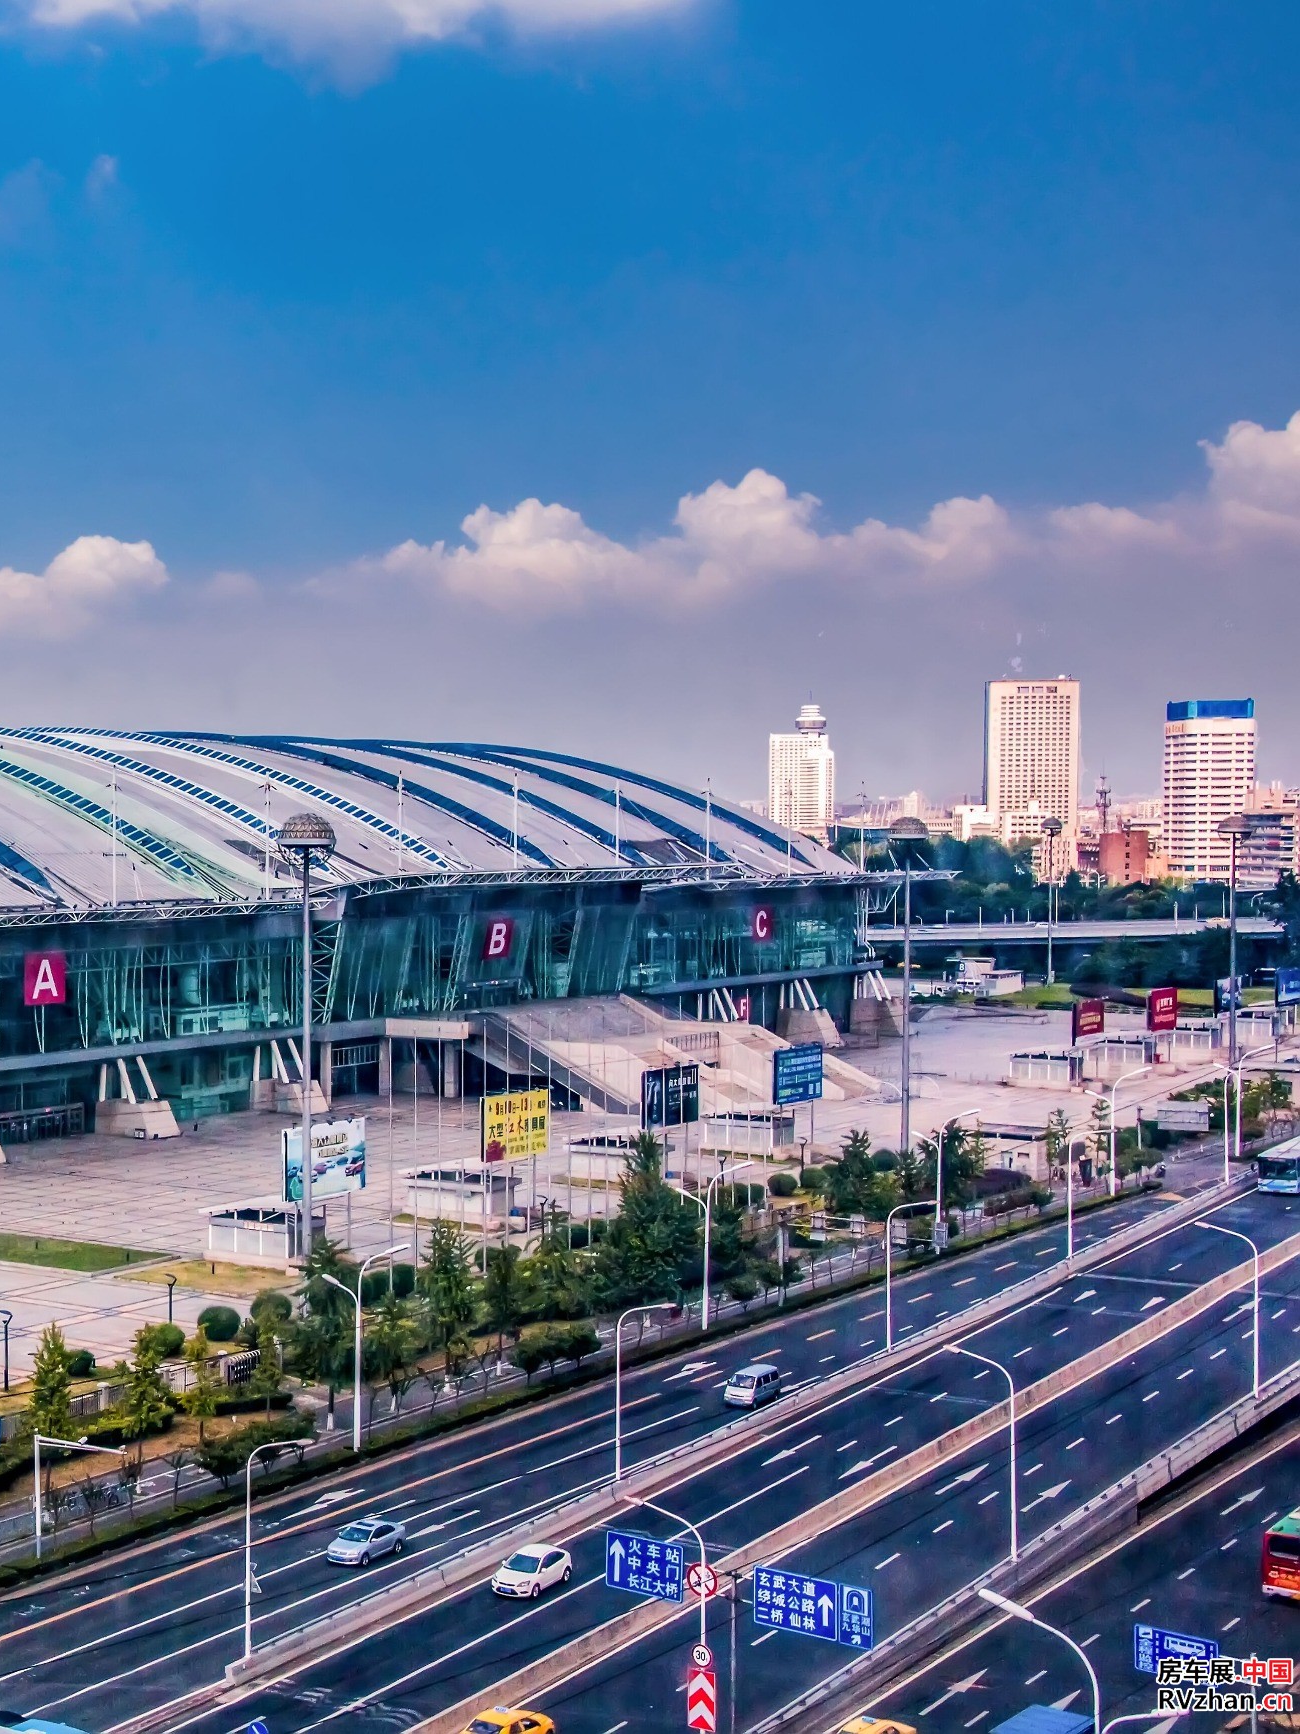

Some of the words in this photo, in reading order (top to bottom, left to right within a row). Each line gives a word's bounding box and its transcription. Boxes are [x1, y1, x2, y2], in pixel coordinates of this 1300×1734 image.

[755, 910, 767, 938] C
[488, 923, 507, 955] B
[32, 959, 58, 999] A
[628, 1538, 680, 1564] 火车站
[627, 1556, 680, 1581] 中央门
[627, 1573, 679, 1598] 长江大桥
[757, 1571, 816, 1597] 玄武大道
[757, 1588, 816, 1615] 绕城公路
[757, 1606, 784, 1625] 二桥
[789, 1612, 816, 1632] 仙林
[841, 1621, 871, 1637] 九华山
